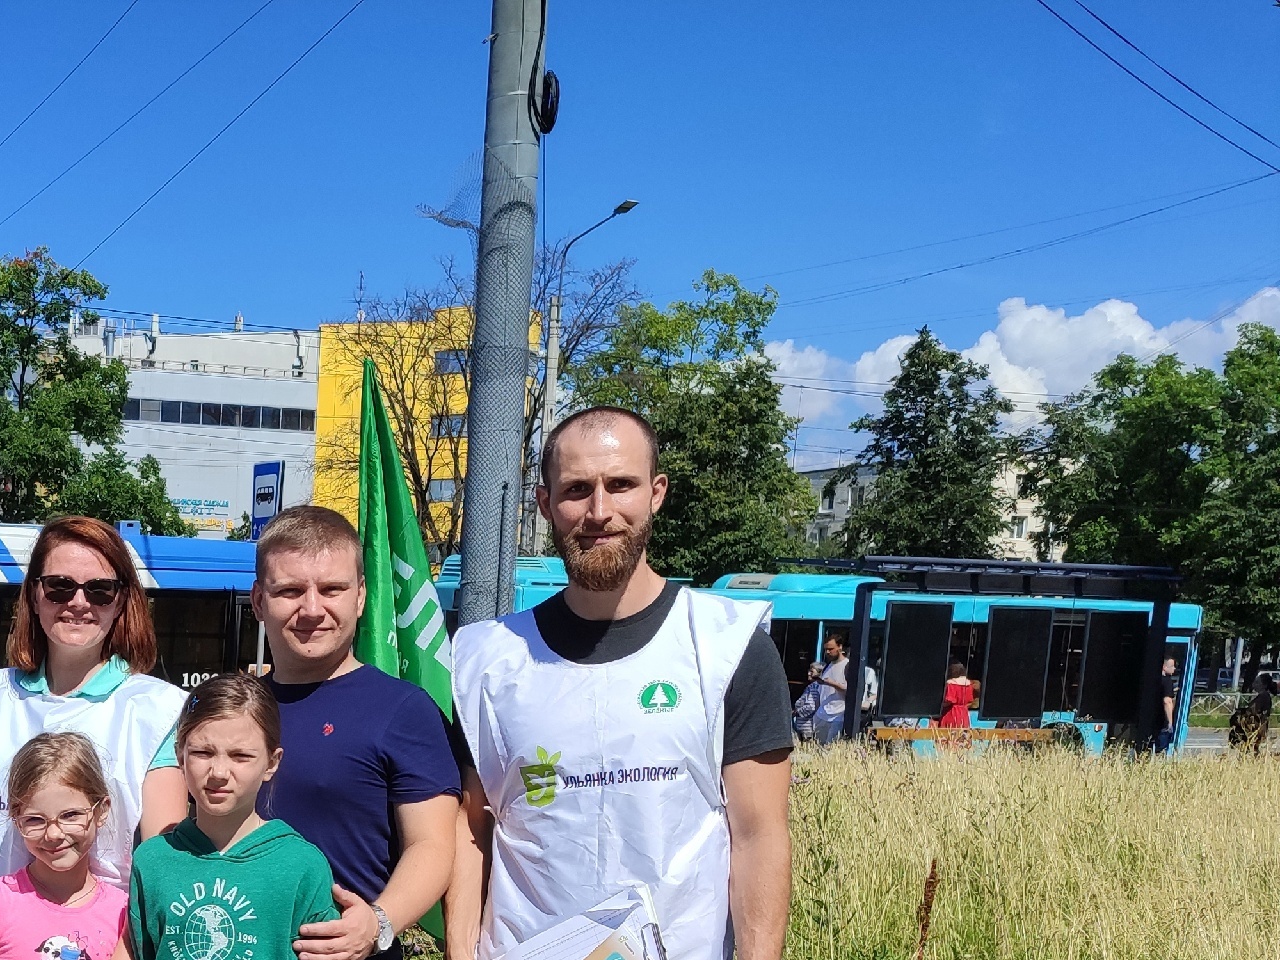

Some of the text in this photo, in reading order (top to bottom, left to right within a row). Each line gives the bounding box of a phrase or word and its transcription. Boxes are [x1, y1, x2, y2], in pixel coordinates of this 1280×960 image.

[562, 766, 679, 789] УЛЬЯНКА ЭКОЛОГИЯ
[169, 877, 258, 922] OLD NAVY
[165, 925, 184, 935] EST.
